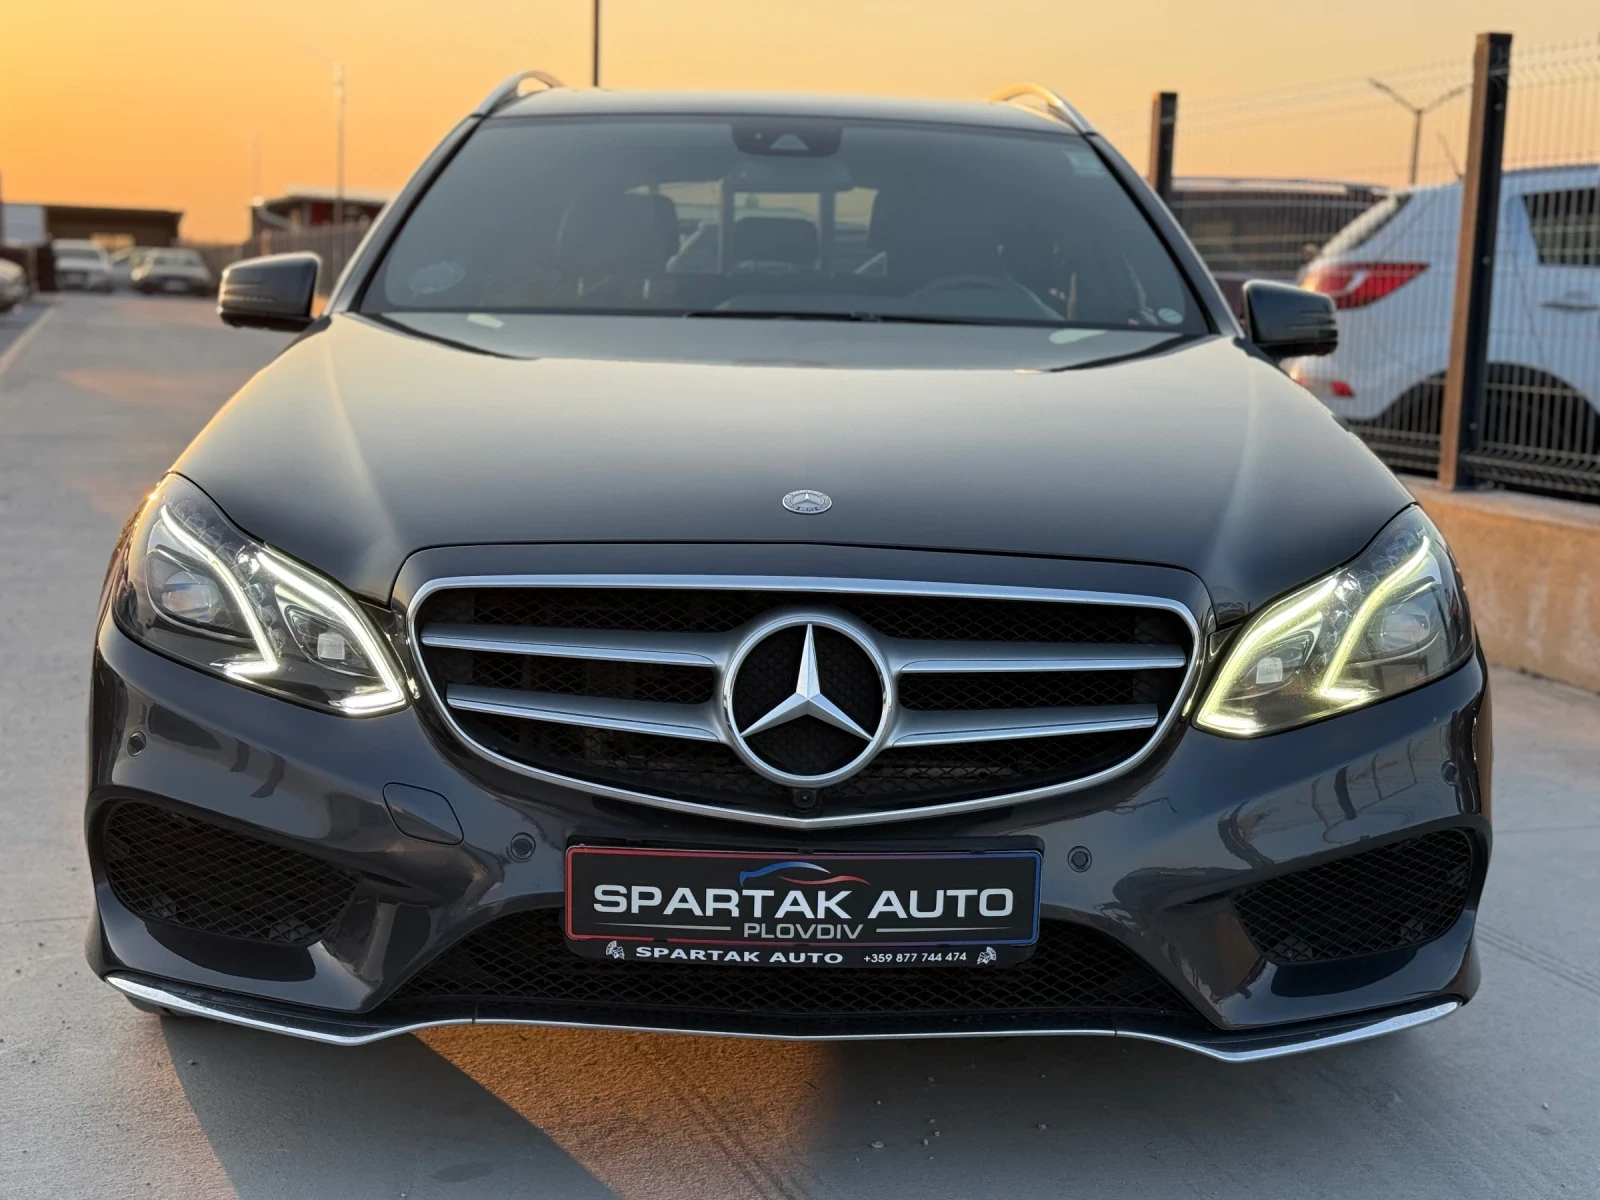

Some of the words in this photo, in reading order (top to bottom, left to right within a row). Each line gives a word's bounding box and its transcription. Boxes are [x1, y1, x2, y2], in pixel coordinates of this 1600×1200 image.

[593, 884, 852, 919] SPARTAK
[867, 889, 1014, 919] AUTO
[743, 922, 864, 940] PLOVDIV
[635, 946, 760, 963] SPARTAK
[769, 952, 844, 964] AUTO
[863, 953, 893, 963] +359
[895, 953, 918, 963] 877
[921, 952, 943, 963] 744
[945, 951, 967, 963] 474
